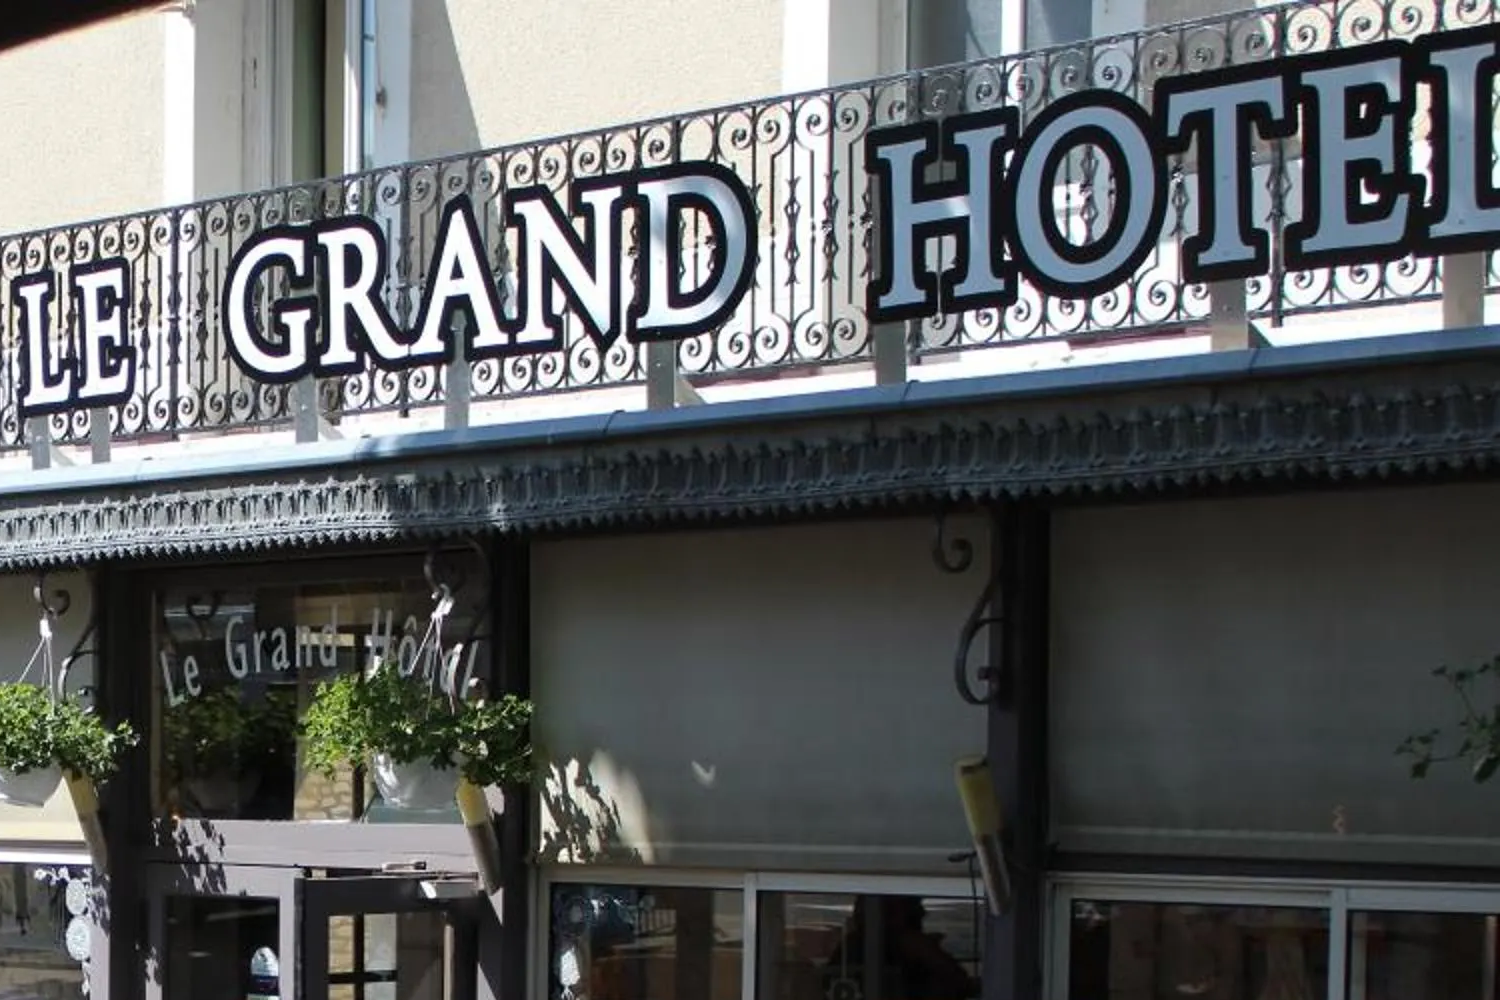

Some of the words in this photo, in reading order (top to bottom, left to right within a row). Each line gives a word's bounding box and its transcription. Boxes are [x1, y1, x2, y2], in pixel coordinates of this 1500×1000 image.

[18, 266, 136, 410] LE
[226, 172, 754, 374] GRAND
[874, 40, 1500, 311] HOTEL
[159, 649, 202, 709] Le
[224, 603, 339, 679] Grand
